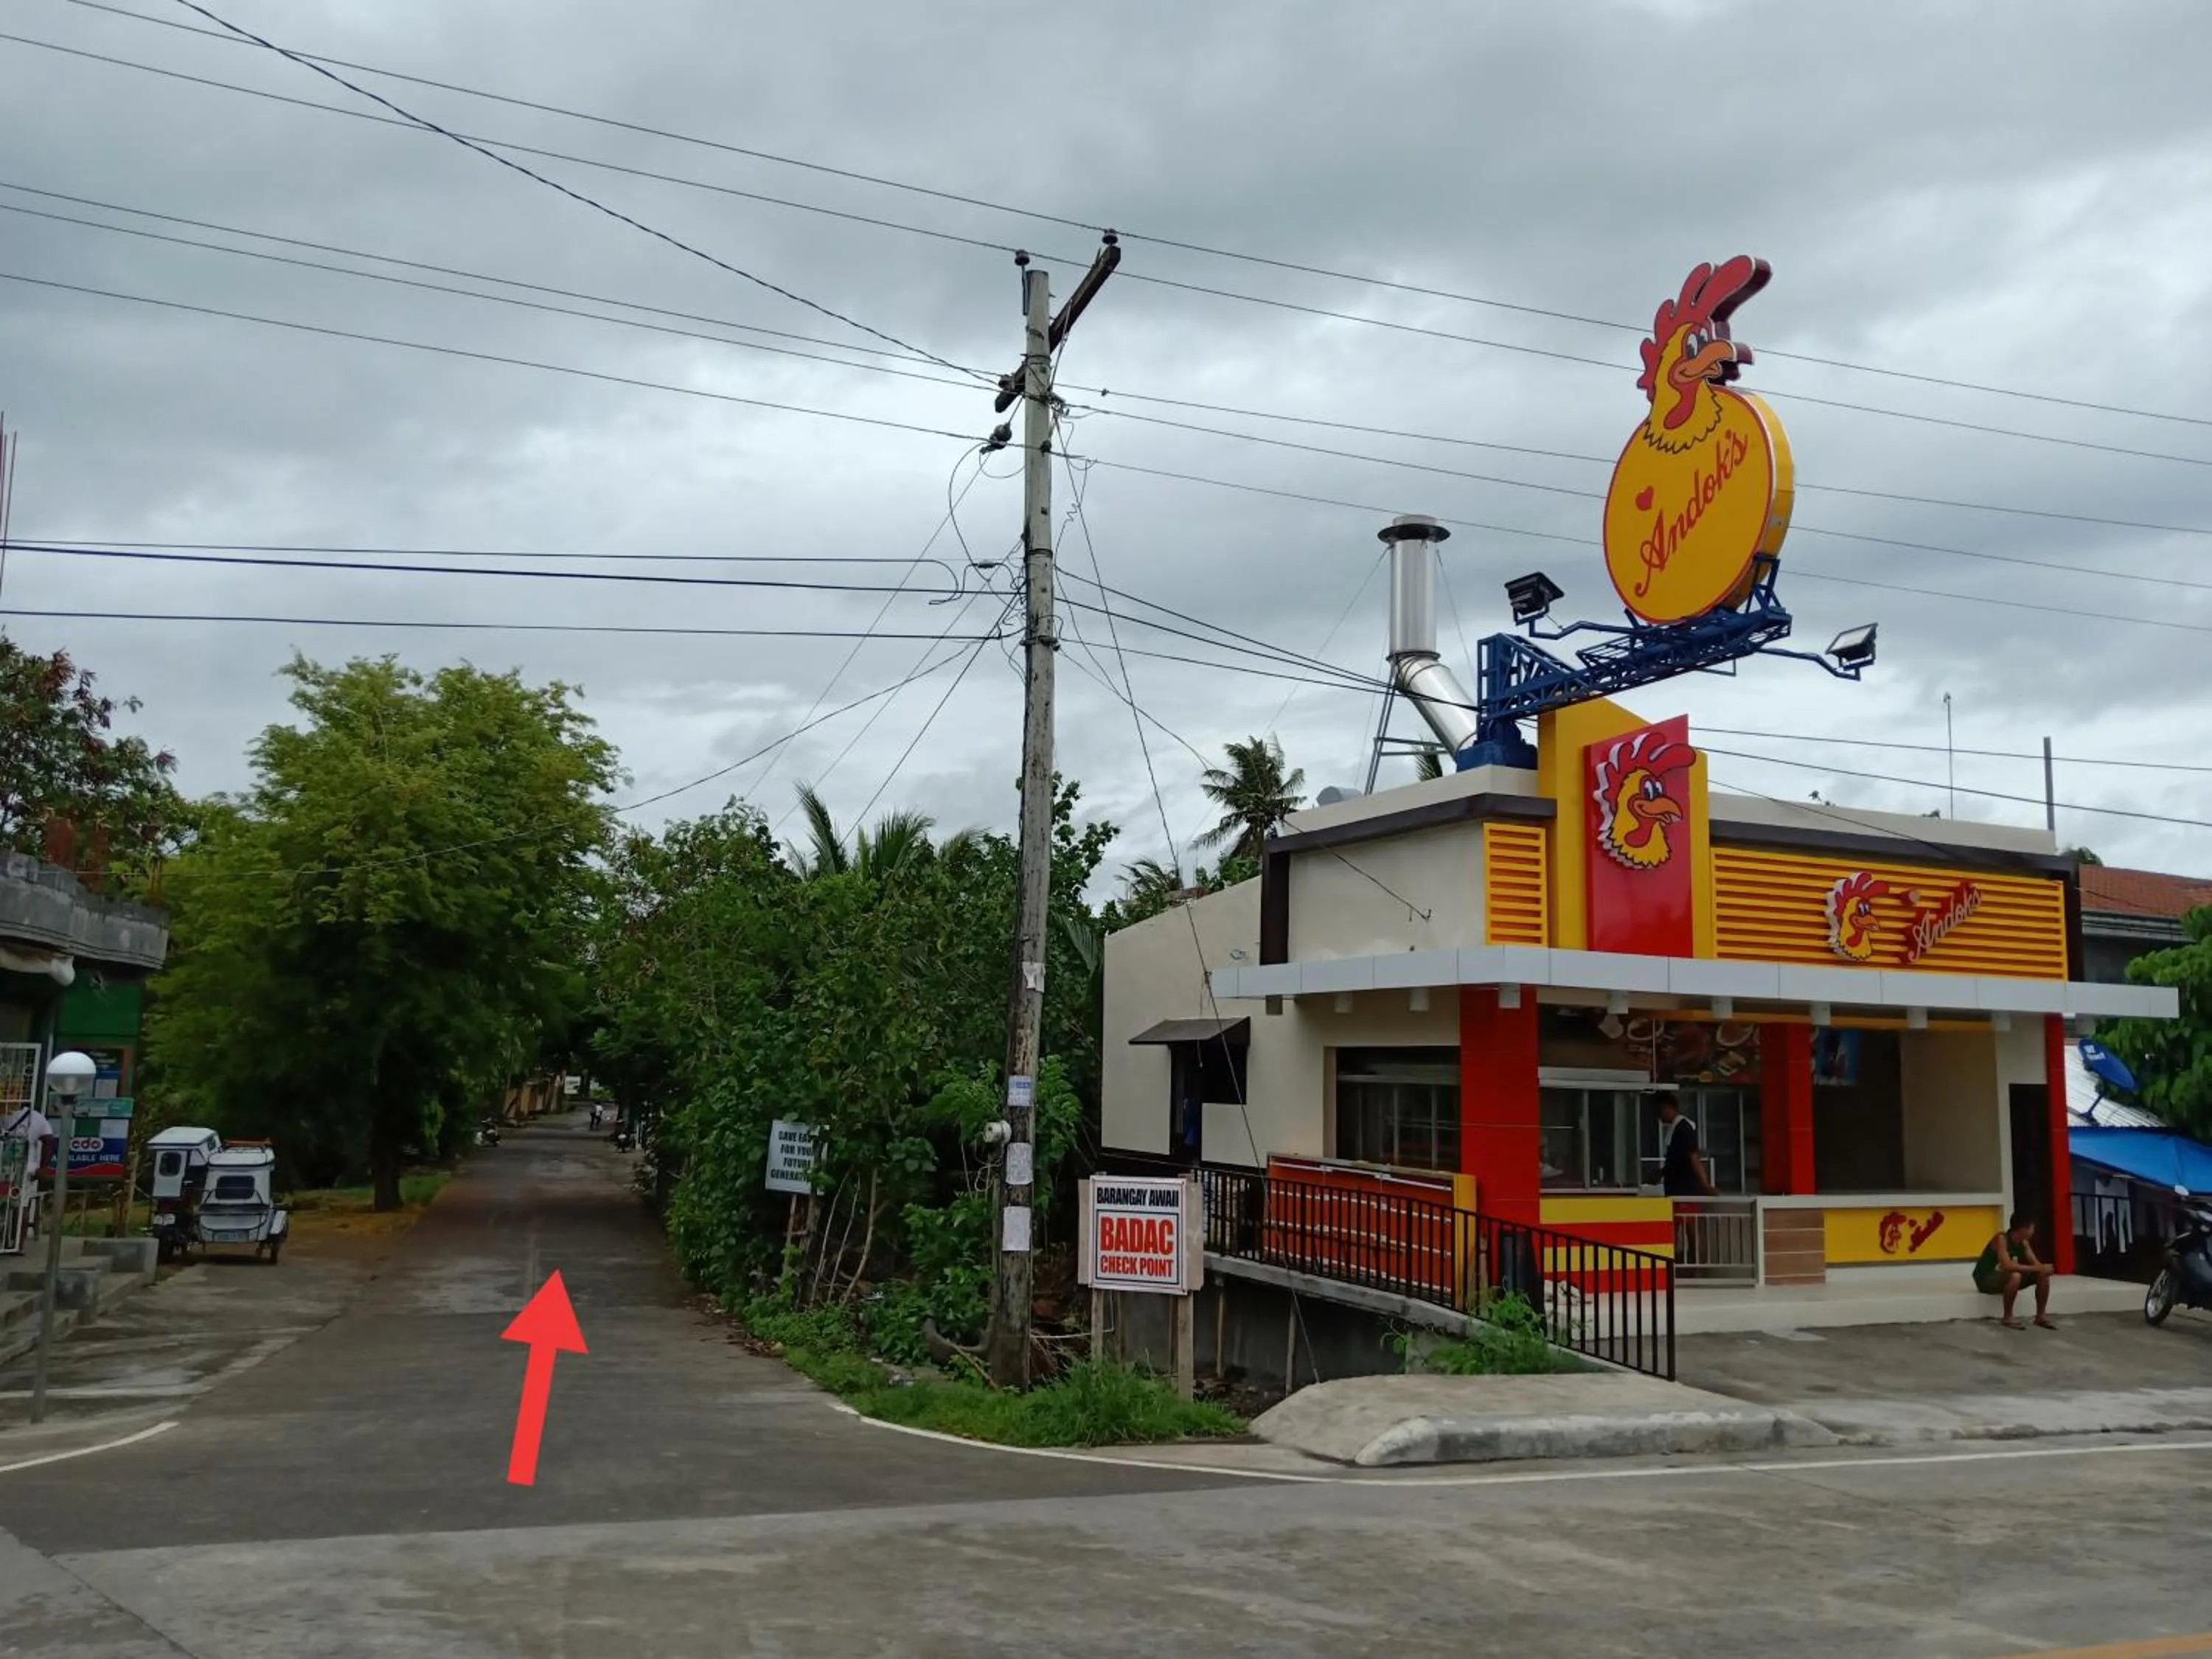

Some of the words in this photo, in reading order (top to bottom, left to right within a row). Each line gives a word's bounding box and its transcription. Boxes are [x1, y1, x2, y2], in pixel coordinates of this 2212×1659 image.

[1634, 428, 1748, 598] Andok's
[1096, 1187, 1147, 1206] BARANGAY
[1100, 1217, 1174, 1255] BADAC
[1100, 1255, 1137, 1275] CHECK
[1140, 1257, 1174, 1277] POINT
